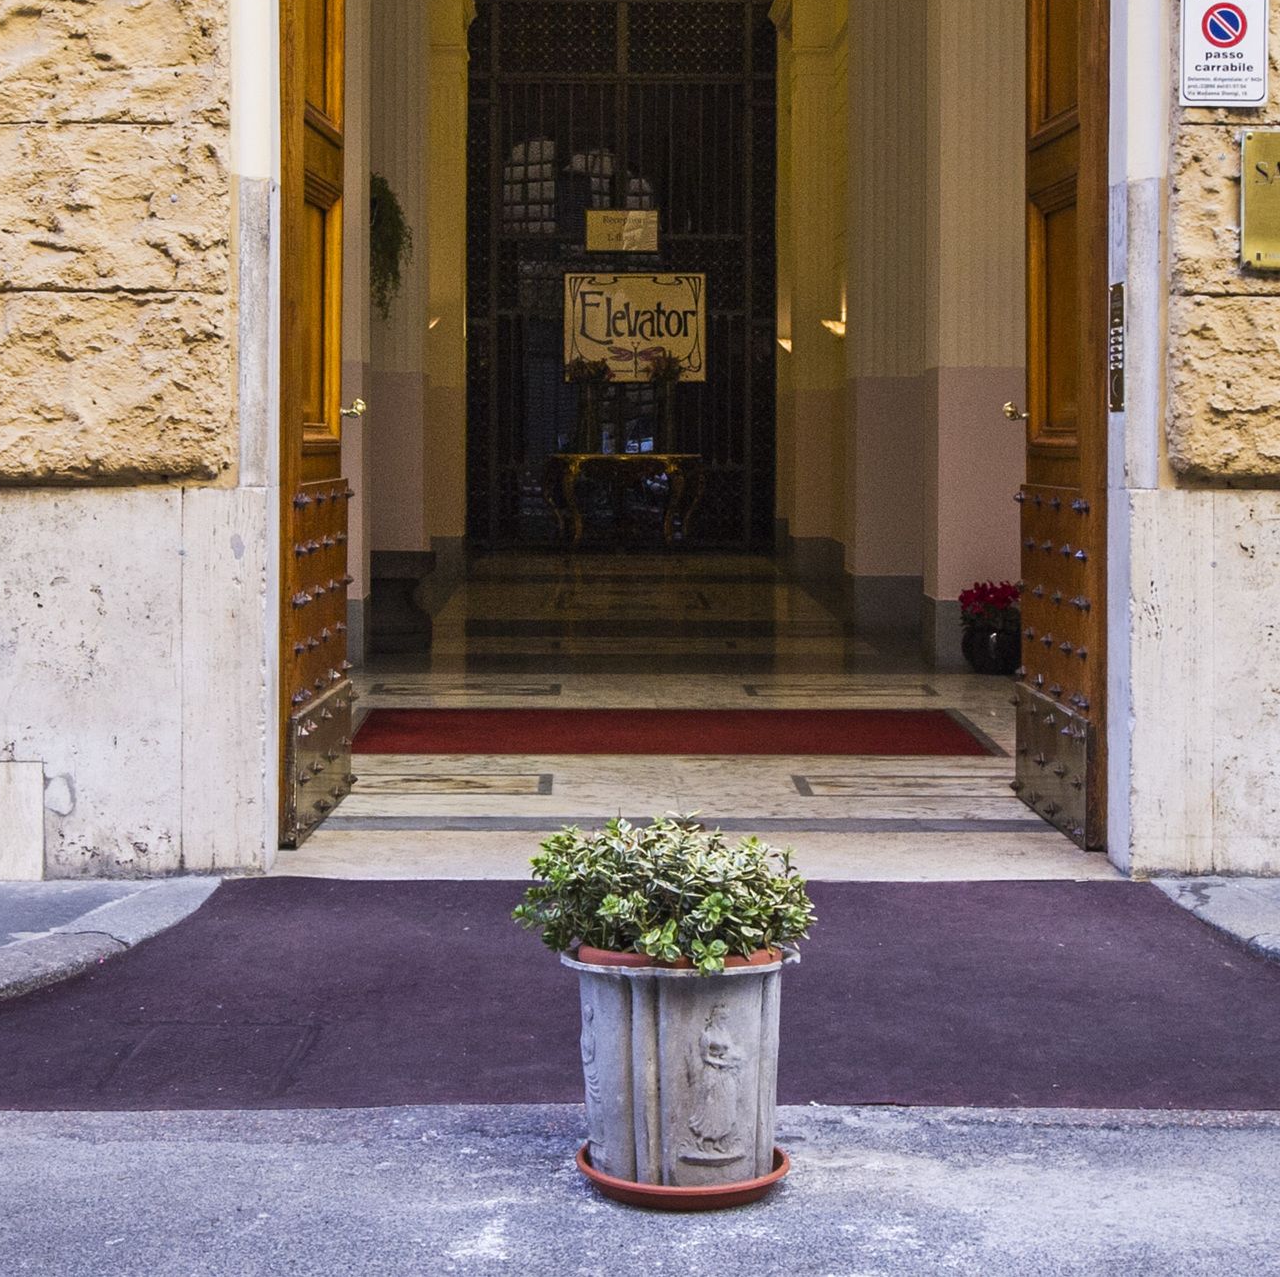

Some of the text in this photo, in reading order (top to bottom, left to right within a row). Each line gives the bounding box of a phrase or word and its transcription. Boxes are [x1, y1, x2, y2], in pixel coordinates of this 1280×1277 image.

[1205, 51, 1244, 61] passo
[1195, 63, 1254, 72] carrabile
[579, 291, 697, 345] Elevator
